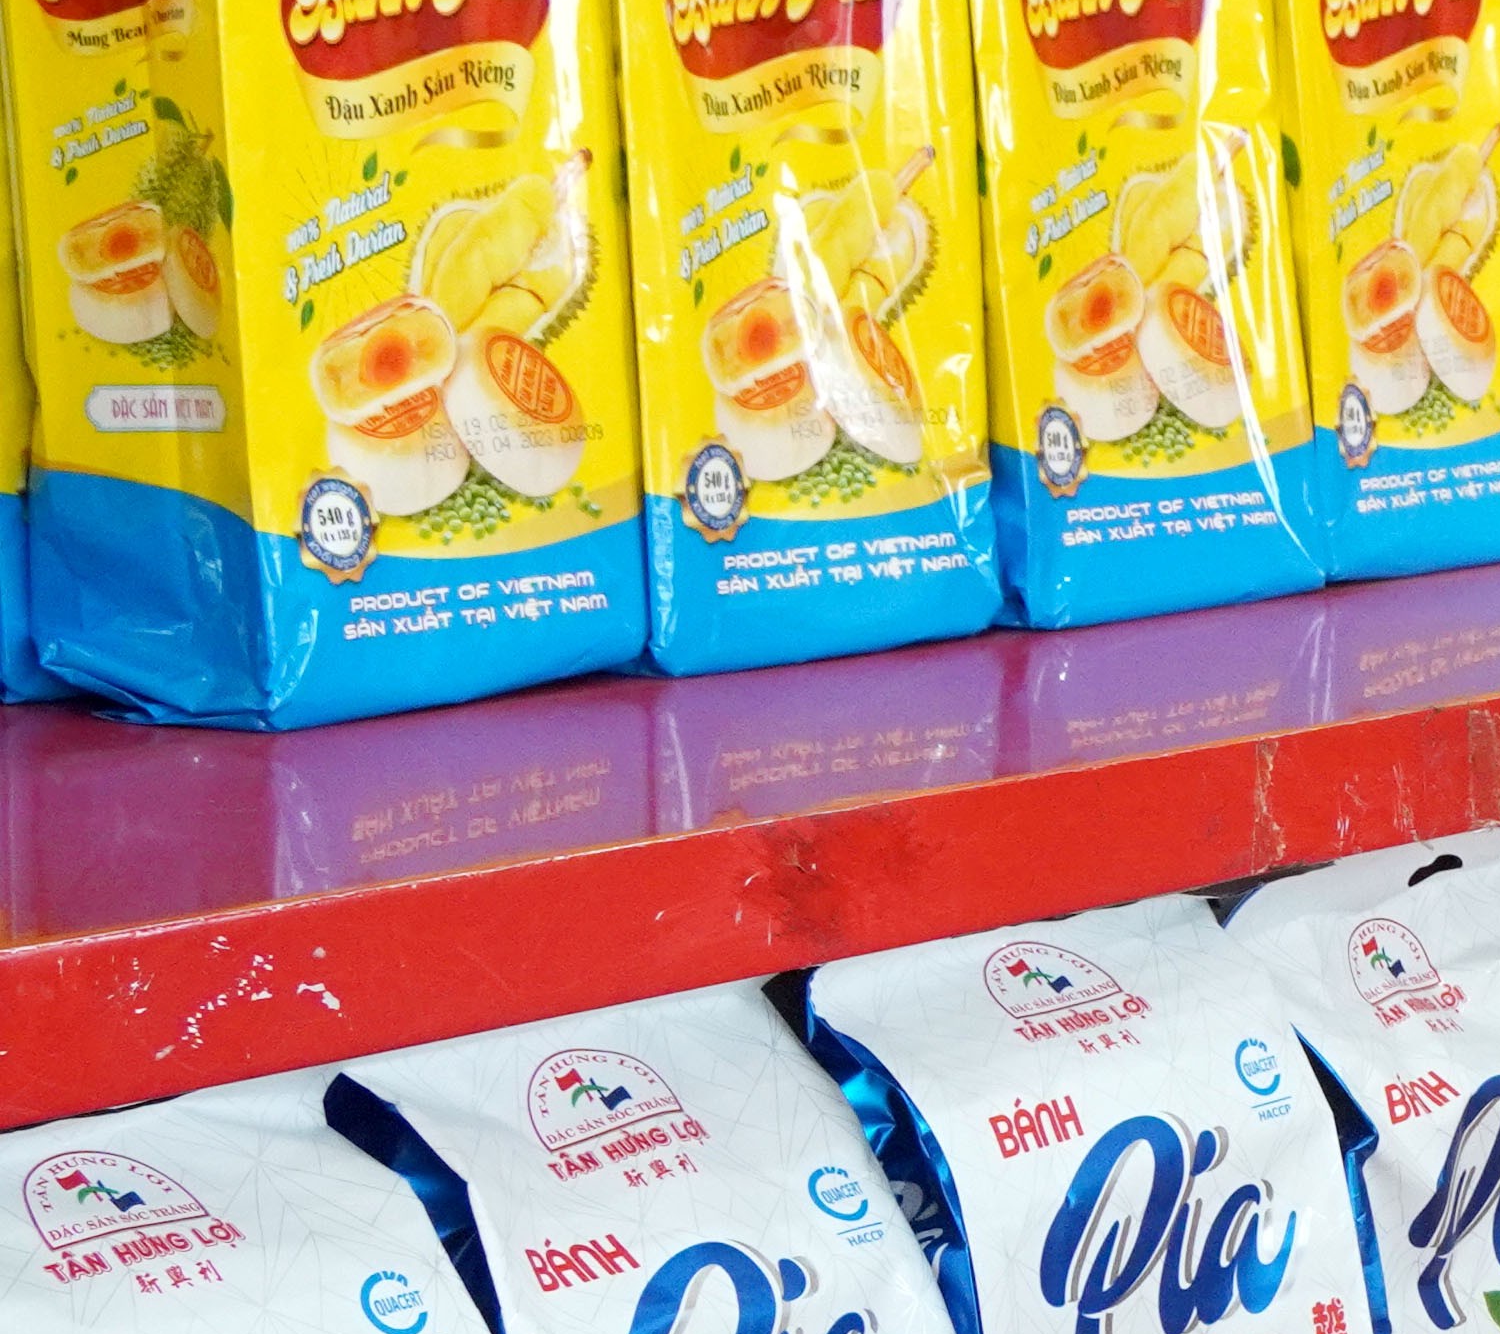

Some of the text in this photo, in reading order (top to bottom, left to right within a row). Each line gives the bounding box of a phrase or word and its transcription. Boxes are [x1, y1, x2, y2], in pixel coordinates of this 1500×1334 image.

[368, 86, 418, 121] Xanh
[458, 58, 517, 93] Riêng
[723, 531, 957, 571] PRODUCT OF VIETNAM
[349, 570, 596, 614] PRODUCT OF VIETNAM
[343, 593, 610, 642] SẢN XUẤT TẠI VIỆT NAM
[1014, 1019, 1056, 1044] TÂN
[989, 1094, 1084, 1159] BÁNH
[1258, 1103, 1292, 1122] HACCP
[547, 1148, 604, 1183] TÂN
[847, 1229, 884, 1247] HACCP
[43, 1249, 112, 1284] TÂN
[525, 1232, 641, 1293] BÁNH
[373, 1289, 425, 1318] QUACERT
